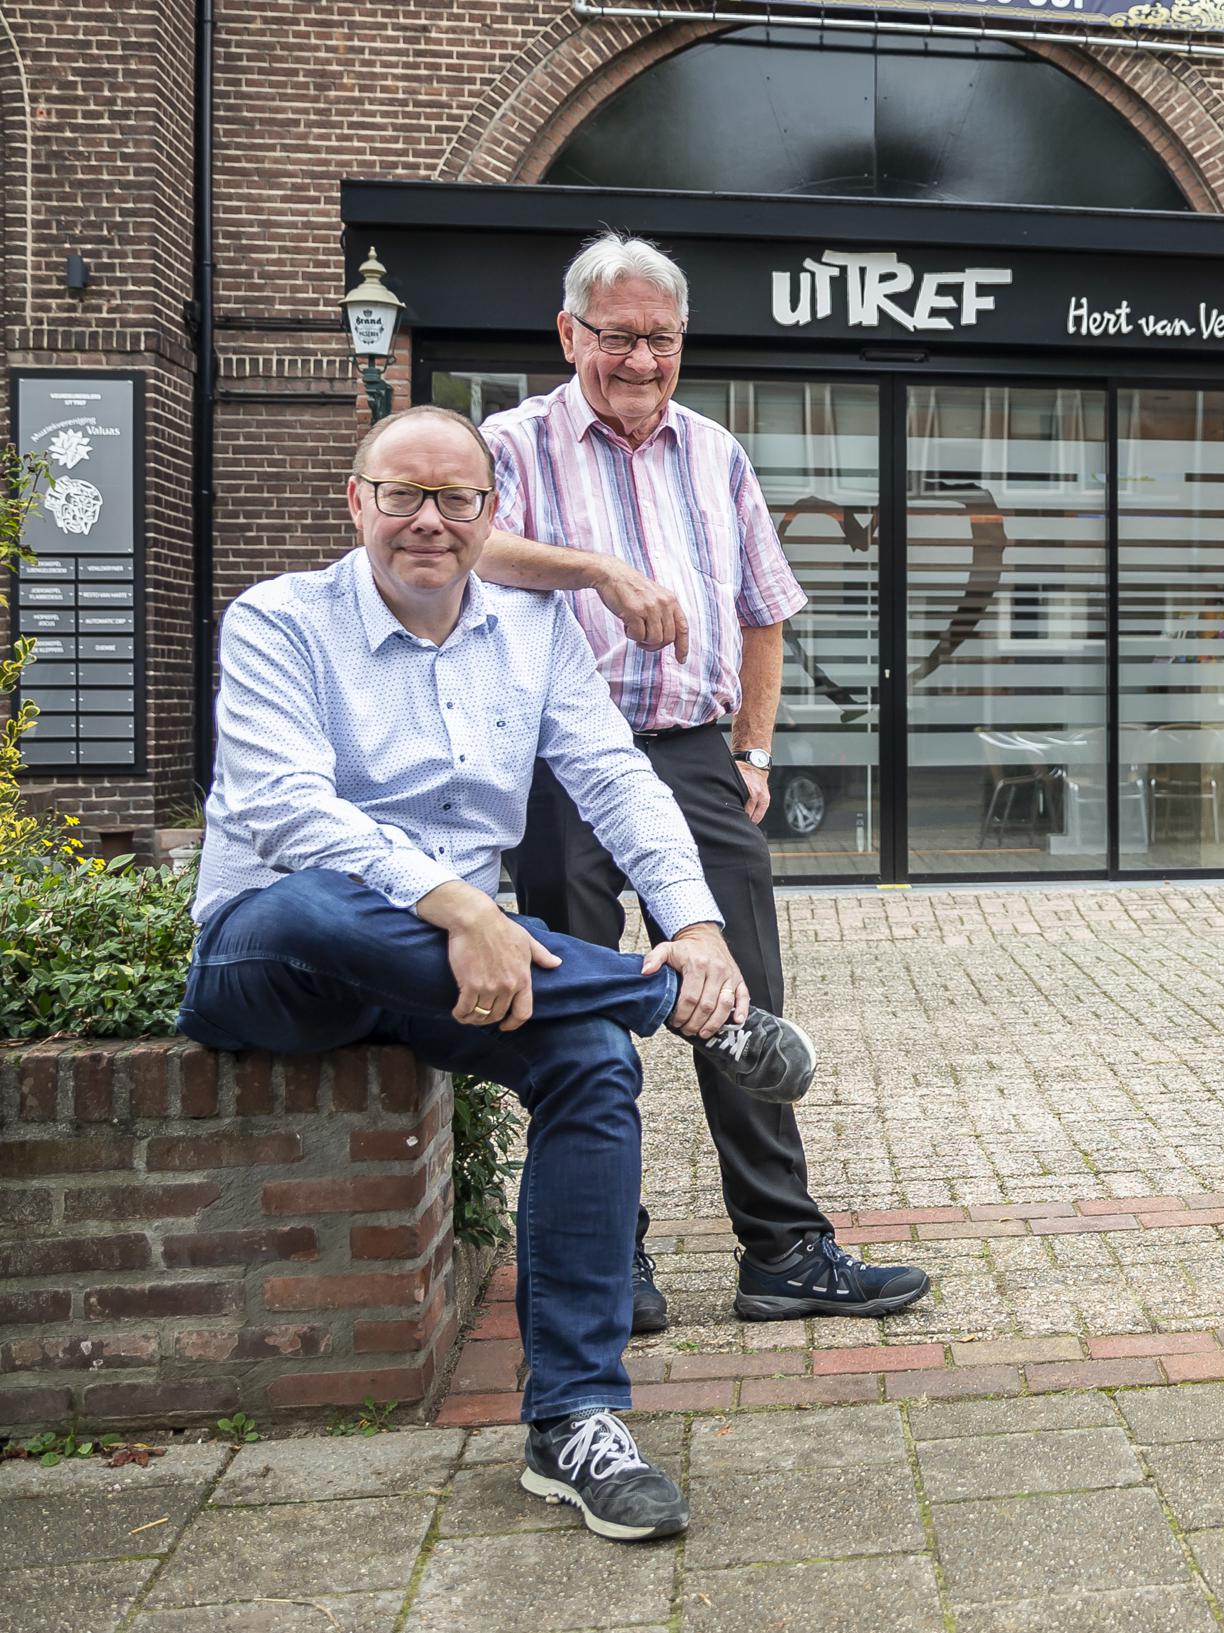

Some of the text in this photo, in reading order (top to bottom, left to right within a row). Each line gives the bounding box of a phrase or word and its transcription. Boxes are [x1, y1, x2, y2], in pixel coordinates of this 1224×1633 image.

[1066, 296, 1133, 336] Hert
[1138, 314, 1196, 337] van
[86, 425, 121, 436] Valuas
